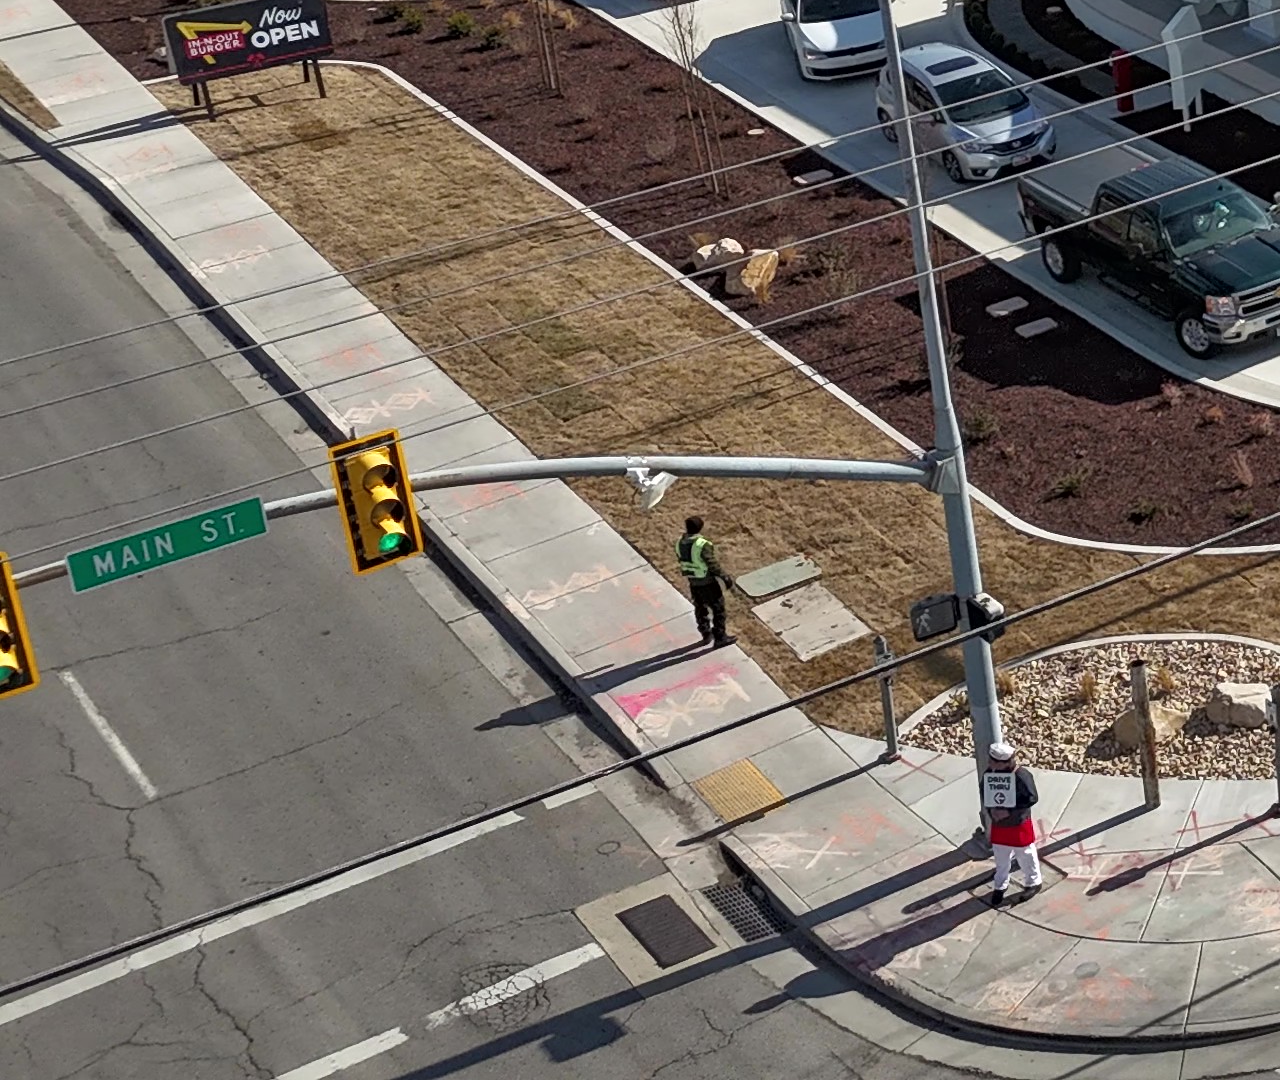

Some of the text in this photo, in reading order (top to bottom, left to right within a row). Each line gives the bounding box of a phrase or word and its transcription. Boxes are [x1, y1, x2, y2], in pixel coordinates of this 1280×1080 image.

[259, 6, 302, 28] Now
[188, 31, 240, 48] IN-N-OUT
[251, 19, 321, 49] OPEN
[190, 39, 242, 57] BURGER
[92, 511, 245, 578] MAIN ST.
[987, 776, 1012, 784] DRIVE
[989, 783, 1011, 791] THRU
